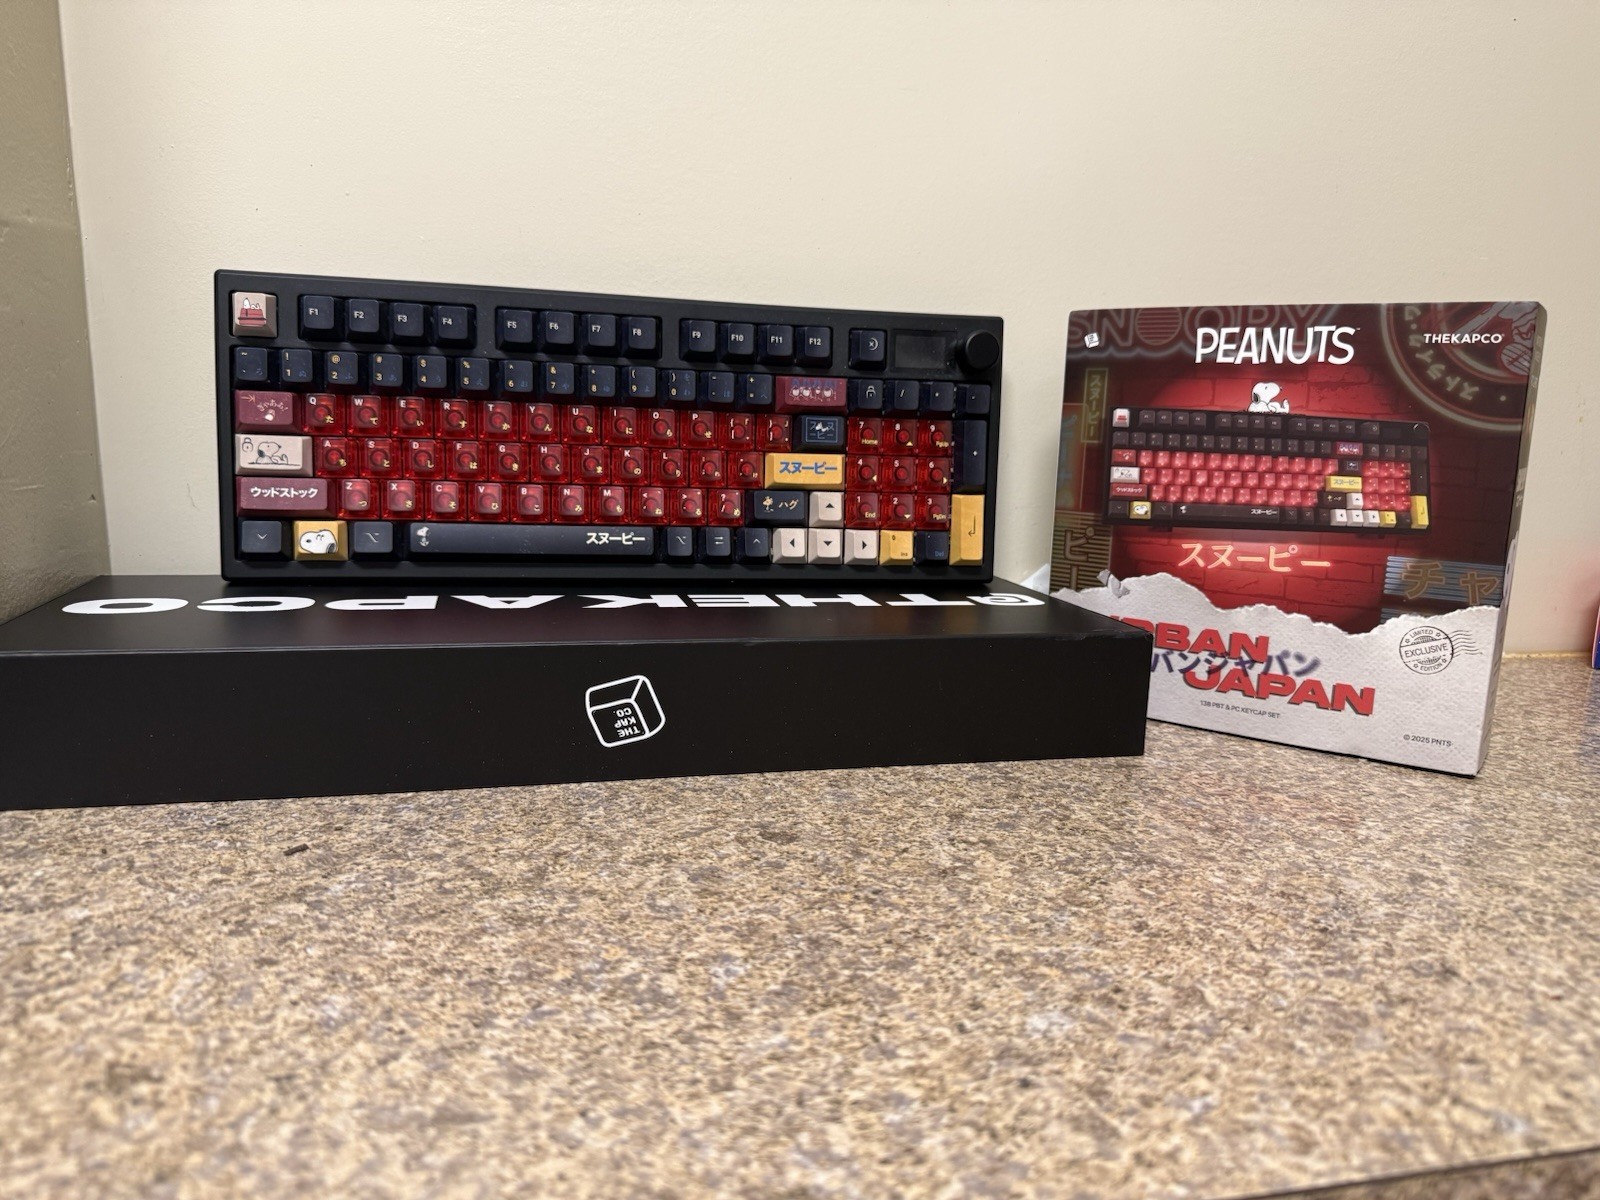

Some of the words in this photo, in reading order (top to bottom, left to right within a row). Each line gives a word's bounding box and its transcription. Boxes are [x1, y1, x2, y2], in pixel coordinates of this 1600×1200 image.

[308, 308, 319, 316] F1
[353, 311, 365, 319] F2
[397, 314, 408, 323] F3
[442, 317, 453, 326] F4
[507, 321, 517, 329] F5
[549, 322, 559, 331] F6
[591, 325, 601, 333] F7
[632, 328, 642, 337] F8
[692, 331, 701, 339] F9
[731, 333, 744, 342] F10
[770, 335, 783, 344] F11
[809, 338, 822, 346] F12
[1195, 325, 1356, 365] PEANUTS
[286, 369, 291, 377] 1
[331, 371, 338, 380] 2
[375, 372, 383, 381] 3
[420, 375, 427, 383] 4
[463, 377, 470, 385] 5
[508, 379, 514, 388] 6
[550, 381, 556, 389] 7
[591, 384, 597, 393] 8
[631, 384, 637, 393] 9
[670, 388, 677, 396] 0
[309, 397, 317, 406] Q
[354, 398, 364, 406] W
[400, 400, 407, 408] E
[443, 402, 451, 411] R
[488, 404, 495, 412] T
[529, 406, 536, 414] Y
[572, 408, 579, 416] U
[613, 409, 617, 417] I
[325, 415, 334, 424] た
[692, 413, 699, 421] P
[501, 422, 511, 431] か
[544, 424, 552, 432] ん
[859, 421, 865, 429] 7
[895, 423, 901, 431] 8
[585, 425, 594, 434] な
[625, 426, 634, 435] に
[324, 440, 331, 448] A
[368, 440, 375, 449] S
[861, 438, 878, 446] Home
[499, 445, 506, 453] G
[541, 446, 548, 454] H
[584, 448, 590, 456] J
[663, 452, 668, 460] L
[383, 459, 390, 468] と
[427, 460, 434, 468] し
[469, 461, 478, 469] は
[778, 460, 838, 475] スヌーピー
[633, 467, 642, 475] の
[345, 482, 353, 490] Z
[391, 483, 398, 491] X
[435, 484, 442, 492] C
[250, 486, 319, 499] ウッドストック
[521, 487, 527, 495] B
[563, 488, 570, 496] N
[603, 489, 611, 497] M
[721, 493, 726, 502] ?
[778, 499, 800, 511] ハグ
[586, 531, 646, 546] スヌーピー
[1177, 542, 1331, 573] スヌーピー
[1404, 642, 1449, 658] EXCLUSIVE
[1183, 665, 1376, 717] JAPAN
[1200, 699, 1212, 708] 138
[1212, 702, 1225, 710] PBT
[1241, 707, 1267, 716] KEYCAP
[614, 716, 637, 728] KAP
[617, 725, 641, 738] THE
[1411, 735, 1430, 744] 2025
[1431, 738, 1452, 748] PNTS
